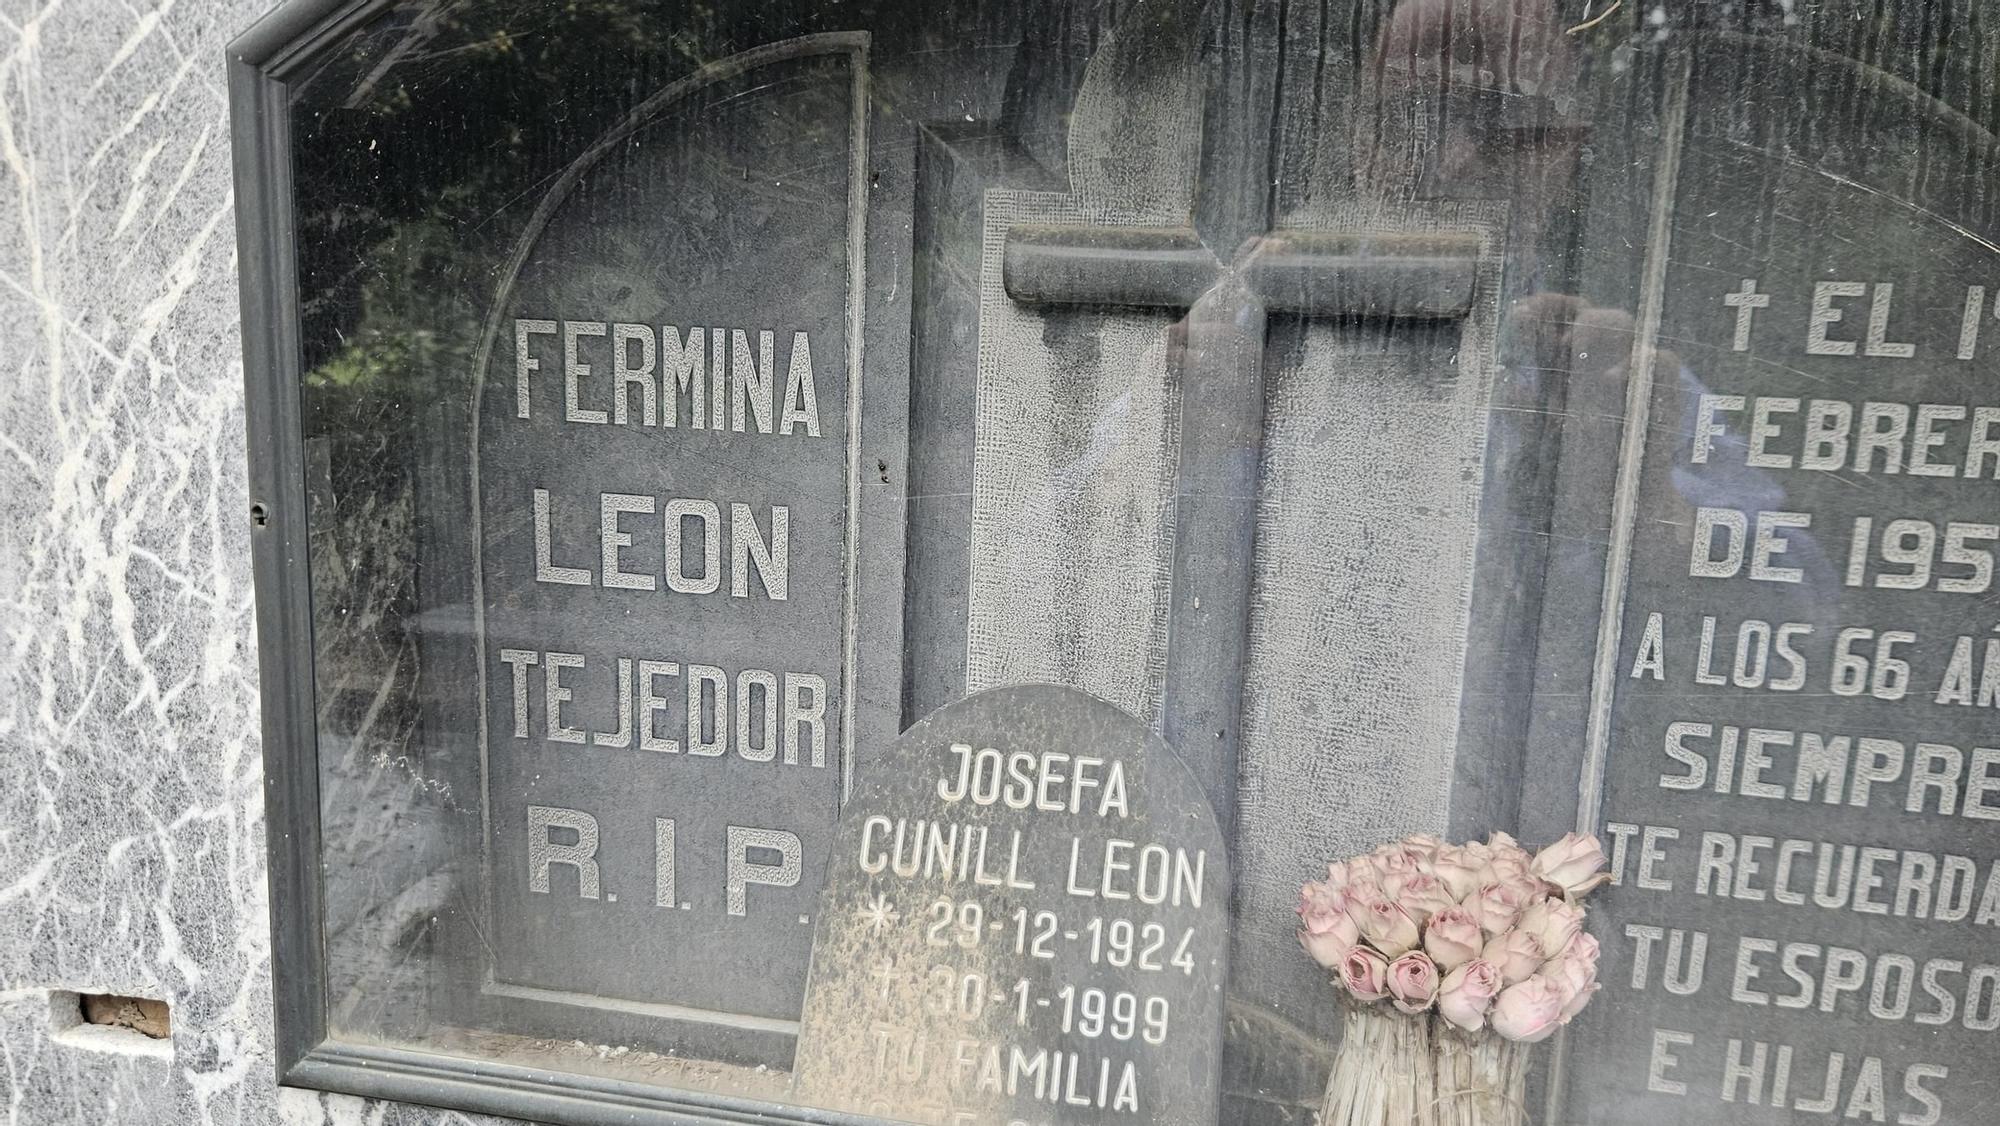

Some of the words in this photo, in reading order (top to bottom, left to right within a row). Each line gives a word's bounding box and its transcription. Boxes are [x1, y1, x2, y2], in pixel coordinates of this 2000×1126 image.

[1805, 282, 1916, 358] EL
[1957, 285, 2000, 360] 1
[515, 319, 822, 438] FERMINA
[534, 488, 789, 601] LEON
[1690, 507, 1812, 583] DE
[1630, 612, 1665, 681] A
[1695, 616, 1815, 692] LOS
[1830, 627, 1917, 700] 66
[500, 649, 827, 768] TEJEDOR
[937, 743, 1128, 818] JOSEFA
[1659, 721, 2000, 821] SIEMPRE
[859, 815, 1036, 889] CUNILL
[1066, 837, 1206, 909] LEON
[1606, 821, 1680, 891] TE
[926, 900, 1196, 975] 29-12-1924
[1625, 923, 1709, 995] TU
[1730, 935, 2000, 1032] ESPOSO
[927, 964, 1170, 1045] 30-1-1999
[870, 1022, 926, 1082] TU
[956, 1037, 1140, 1113] FAMILIA
[1647, 1027, 1695, 1097] E
[1719, 1038, 1949, 1126] HIJAS
